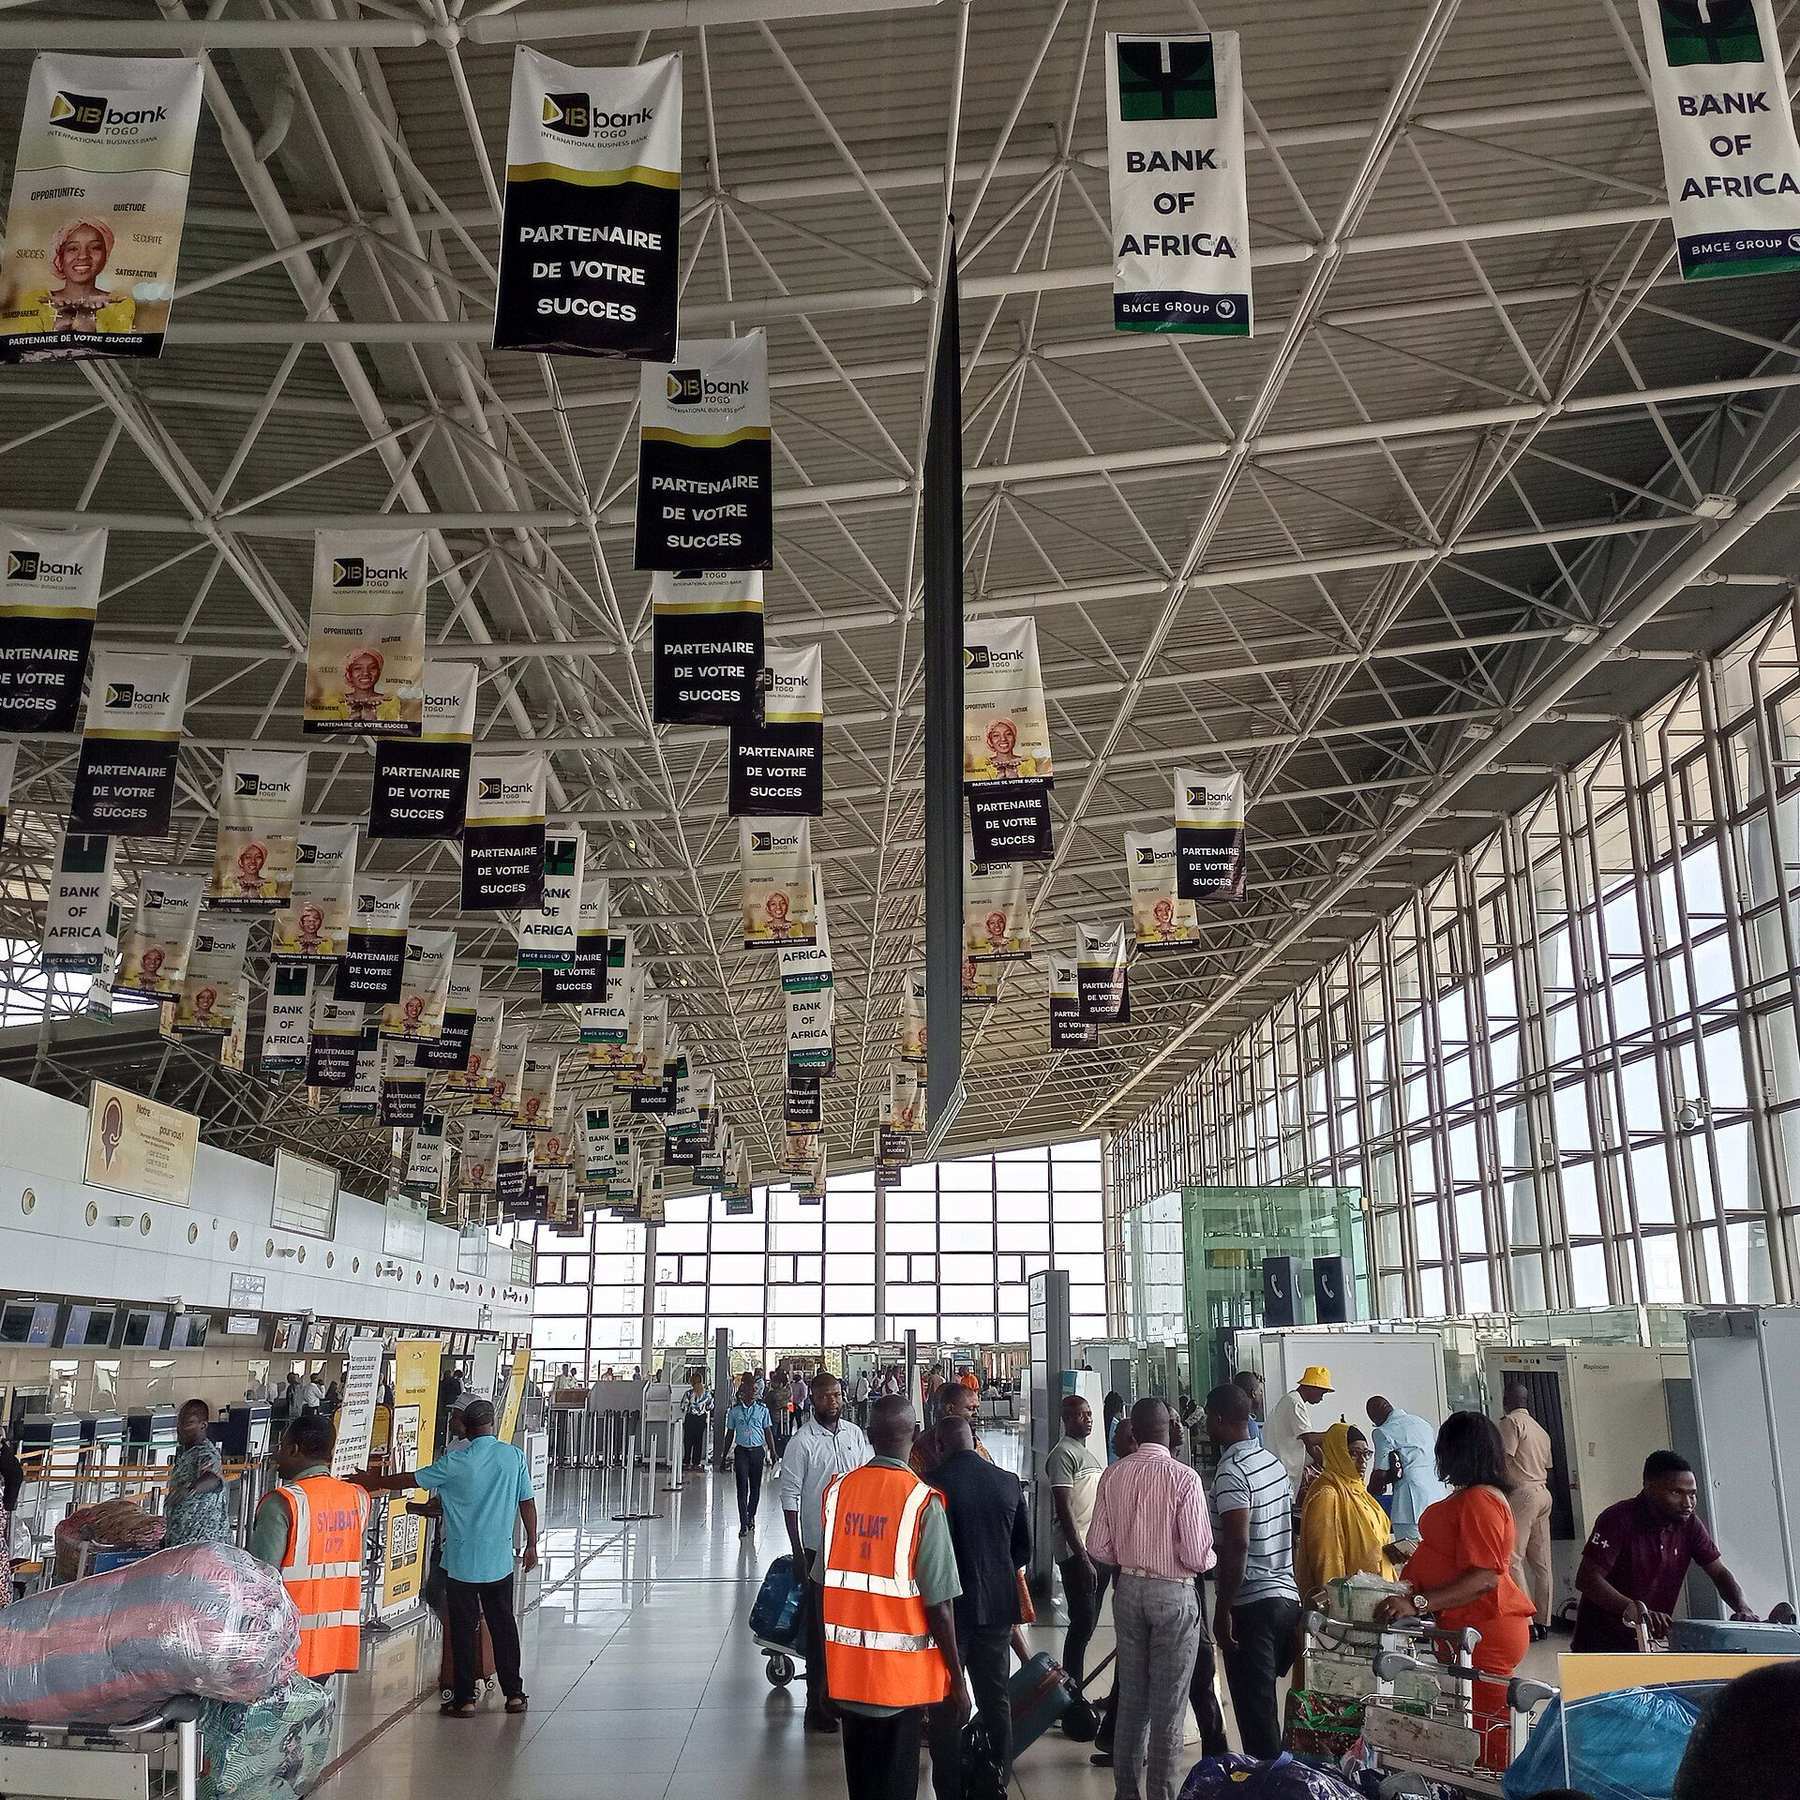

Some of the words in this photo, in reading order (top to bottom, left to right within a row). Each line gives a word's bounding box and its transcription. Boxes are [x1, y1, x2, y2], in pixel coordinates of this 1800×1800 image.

[1678, 91, 1770, 116] BANK
[107, 106, 168, 124] bank
[593, 107, 653, 128] bank
[104, 126, 139, 135] TOGO
[593, 130, 627, 138] TOGO
[48, 130, 104, 144] INTERNATIONAL
[540, 131, 596, 148] INTERNATIONAL
[598, 140, 630, 148] BUSINESS
[1710, 135, 1752, 157] OF
[1127, 149, 1216, 173] BANK
[1680, 173, 1800, 201] AFRICA
[1153, 192, 1194, 214] OF
[520, 225, 662, 250] PARTENAIRE
[1118, 233, 1236, 259] AFRICA
[1691, 242, 1731, 255] BMCE
[1736, 239, 1782, 251] GROUP
[115, 268, 158, 279] SATISFACTION
[533, 262, 562, 278] DE
[570, 261, 646, 285] VOTRE
[536, 298, 636, 322] SUCCES
[1122, 302, 1160, 313] BMCE
[1164, 302, 1210, 313] GROUP
[9, 336, 58, 345] PARTENAIRE
[61, 334, 71, 342] DE
[73, 334, 103, 342] VOTRE
[704, 379, 749, 394] bank
[705, 396, 730, 404] TOGO
[652, 476, 759, 494] PARTENAIRE
[663, 506, 685, 520] DE
[692, 504, 748, 521] VOTRE
[666, 533, 742, 548] SUCCES
[40, 560, 84, 575] bank
[366, 567, 408, 579] bank
[664, 642, 754, 655] PARTENAIRE
[0, 648, 79, 661] ARTENAIRE
[990, 650, 1024, 661] bank
[674, 667, 693, 678] DE
[697, 666, 745, 678] VOTRE
[17, 673, 65, 685] VOTRE
[775, 674, 808, 686] bank
[134, 691, 170, 704] bank
[424, 695, 459, 707] bank
[679, 690, 741, 702] SUCCES
[739, 746, 814, 757] PARTENAIRE
[87, 765, 167, 777] PARTENAIRE
[382, 766, 460, 779] PARTENAIRE
[746, 766, 762, 776] DE
[766, 767, 806, 777] VOTRE
[92, 785, 109, 797] DE
[113, 786, 155, 798] VOTRE
[259, 782, 291, 792] bank
[388, 786, 405, 797] DE
[409, 788, 450, 799] VOTRE
[503, 783, 533, 794] bank
[750, 787, 802, 797] SUCCES
[1207, 791, 1232, 802] bank
[977, 799, 1042, 812] PARTENAIRE
[93, 807, 147, 819] SUCCES
[390, 808, 444, 820] SUCCES
[985, 819, 1000, 829] DE
[1002, 817, 1037, 828] VOTRE
[772, 835, 799, 845] bank
[991, 835, 1035, 847] SUCCES
[316, 850, 344, 860] bank
[471, 847, 537, 858] PARTENAIRE
[1182, 847, 1240, 857] PARTENAIRE
[478, 866, 492, 876] DE
[495, 864, 530, 876] VOTRE
[1189, 863, 1201, 871] DE
[1204, 863, 1234, 872] VOTRE
[1192, 877, 1232, 886] SUCCES
[59, 887, 100, 897] BANK
[480, 883, 526, 894] SUCCES
[163, 897, 189, 908] bank
[68, 907, 88, 918] OF
[542, 907, 559, 916] OF
[48, 926, 102, 938] AFRICA
[523, 925, 573, 936] AFRICA
[346, 952, 399, 962] PARTENAIRE
[423, 952, 444, 960] bank
[782, 950, 827, 962] AFRICA
[349, 966, 361, 974] DE
[364, 968, 392, 976] VOTRE
[568, 968, 596, 976] VOTRE
[350, 982, 388, 990] SUCCES
[451, 984, 471, 993] bank
[272, 1006, 303, 1014] BANK
[585, 1008, 626, 1017] AFRICA
[792, 1002, 821, 1012] BANK
[279, 1021, 294, 1029] OF
[801, 1016, 815, 1025] OF
[266, 1035, 305, 1044] AFRICA
[790, 1029, 828, 1040] AFRICA
[315, 1048, 356, 1056] PARTENAIRE
[428, 1051, 458, 1059] SUCCES
[328, 1059, 350, 1067] VOTRE
[416, 1142, 439, 1151] BANK
[587, 1154, 614, 1162] AFRICA
[409, 1165, 438, 1174] AFRICA
